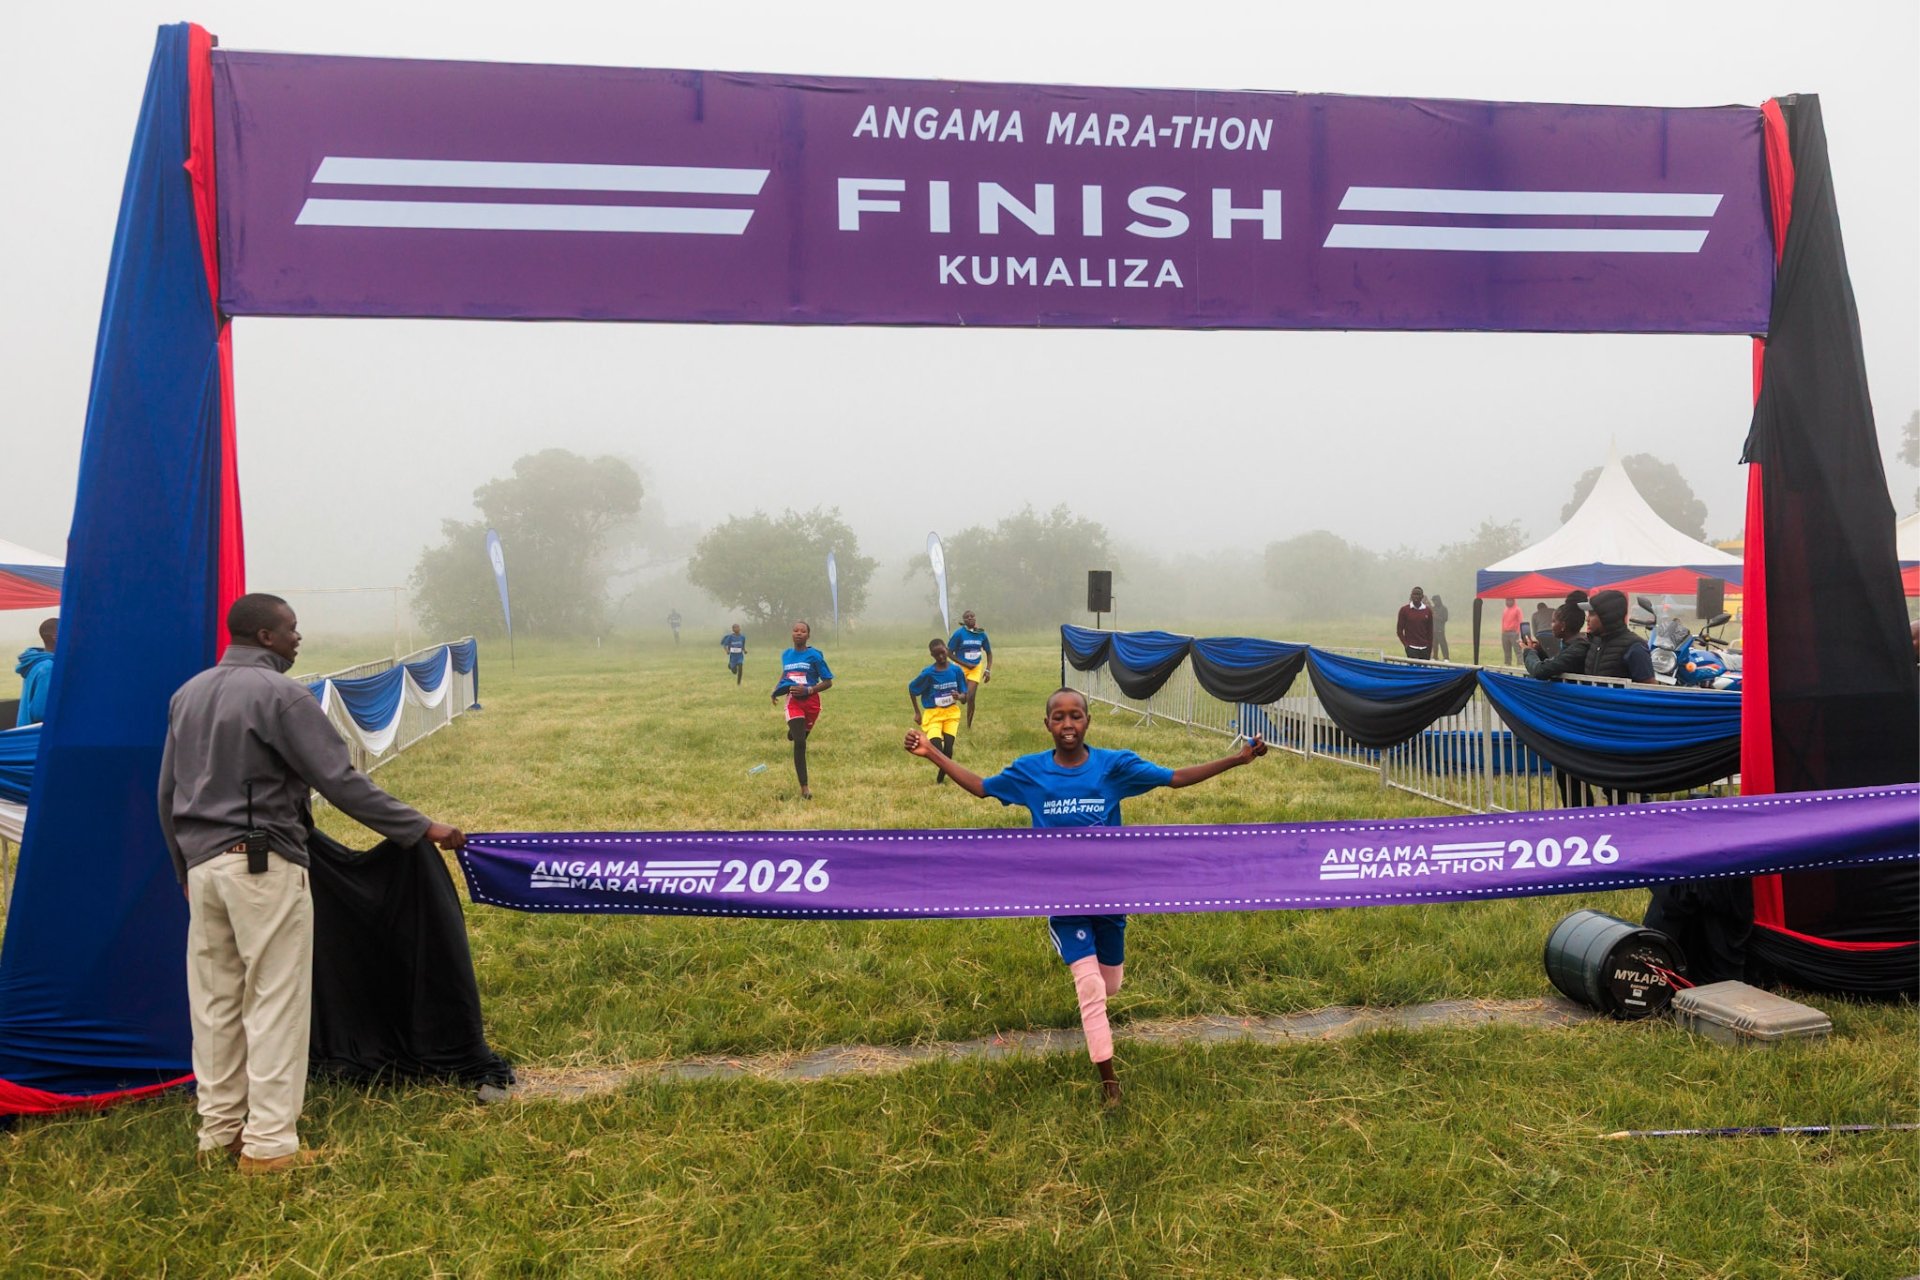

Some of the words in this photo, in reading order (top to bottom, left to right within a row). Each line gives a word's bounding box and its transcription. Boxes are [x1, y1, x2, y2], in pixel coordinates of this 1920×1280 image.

[852, 105, 1024, 143] ANGAMA
[1046, 111, 1274, 151] MARA-THON
[837, 177, 1282, 241] FINISH
[938, 255, 1184, 288] KUMALIZA
[1050, 804, 1105, 815] MARA-THON
[1322, 845, 1428, 864] ANGAMA
[1508, 834, 1620, 870] 2026
[532, 860, 640, 877] ANGAMA
[719, 859, 830, 893] 2026
[1359, 857, 1505, 880] MARA-THON
[570, 877, 716, 894] MARA-THON
[1614, 969, 1667, 987] MYLAPS
